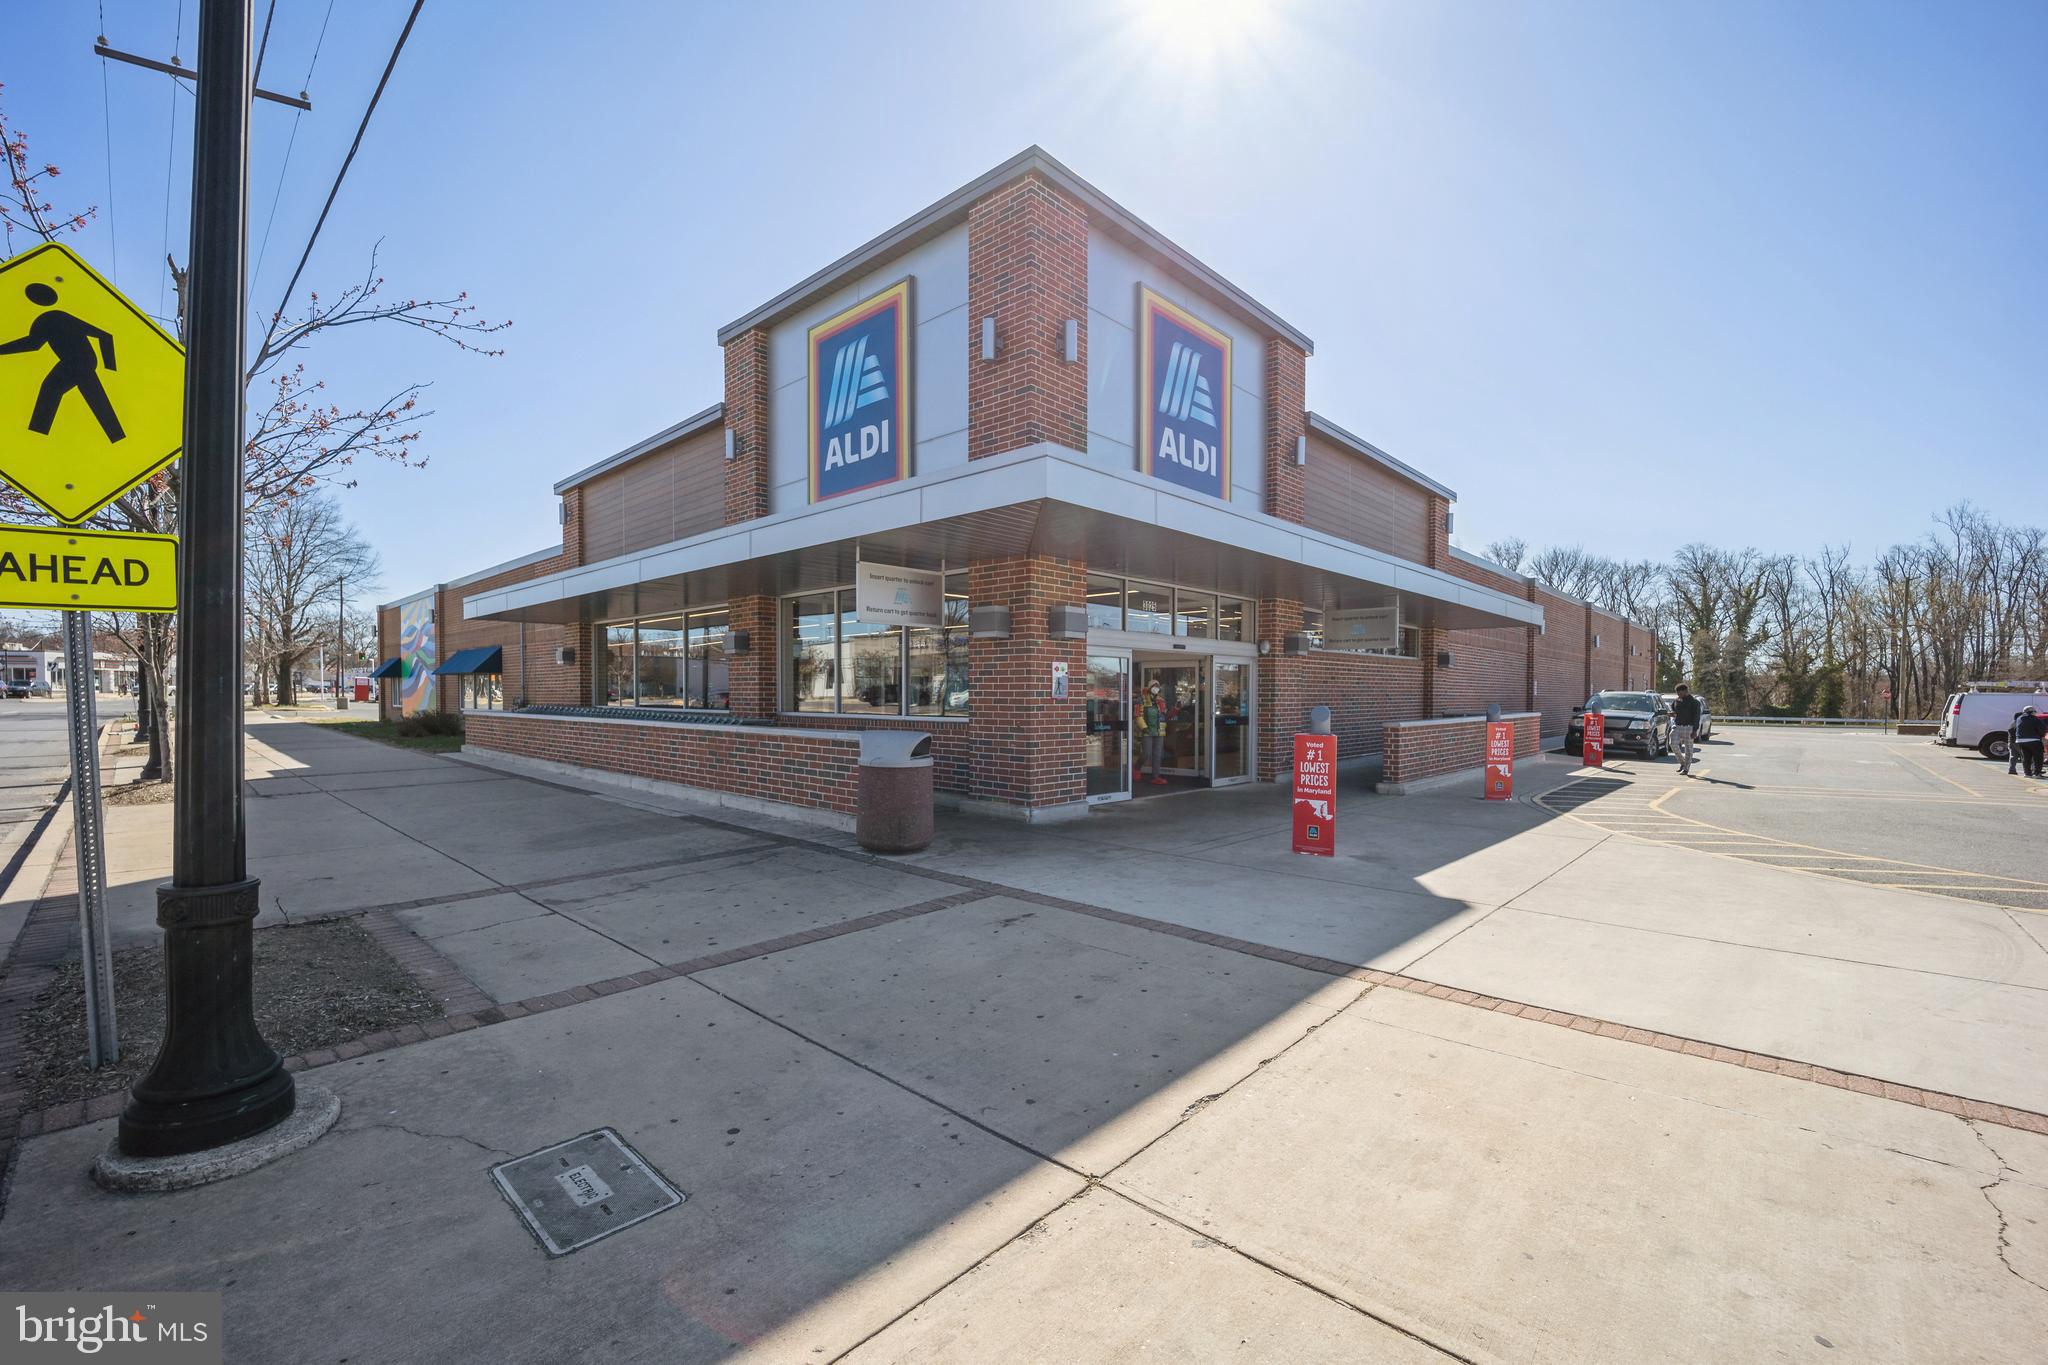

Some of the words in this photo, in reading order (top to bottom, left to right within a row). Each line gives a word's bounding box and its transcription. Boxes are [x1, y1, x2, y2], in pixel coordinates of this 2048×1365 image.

[825, 419, 889, 472] ALDI
[1159, 426, 1217, 477] ALDI
[0, 551, 150, 587] AHEAD
[1300, 762, 1330, 774] LOWEST
[1300, 774, 1329, 787] PRICES
[568, 1171, 599, 1200] ELECTRIC
